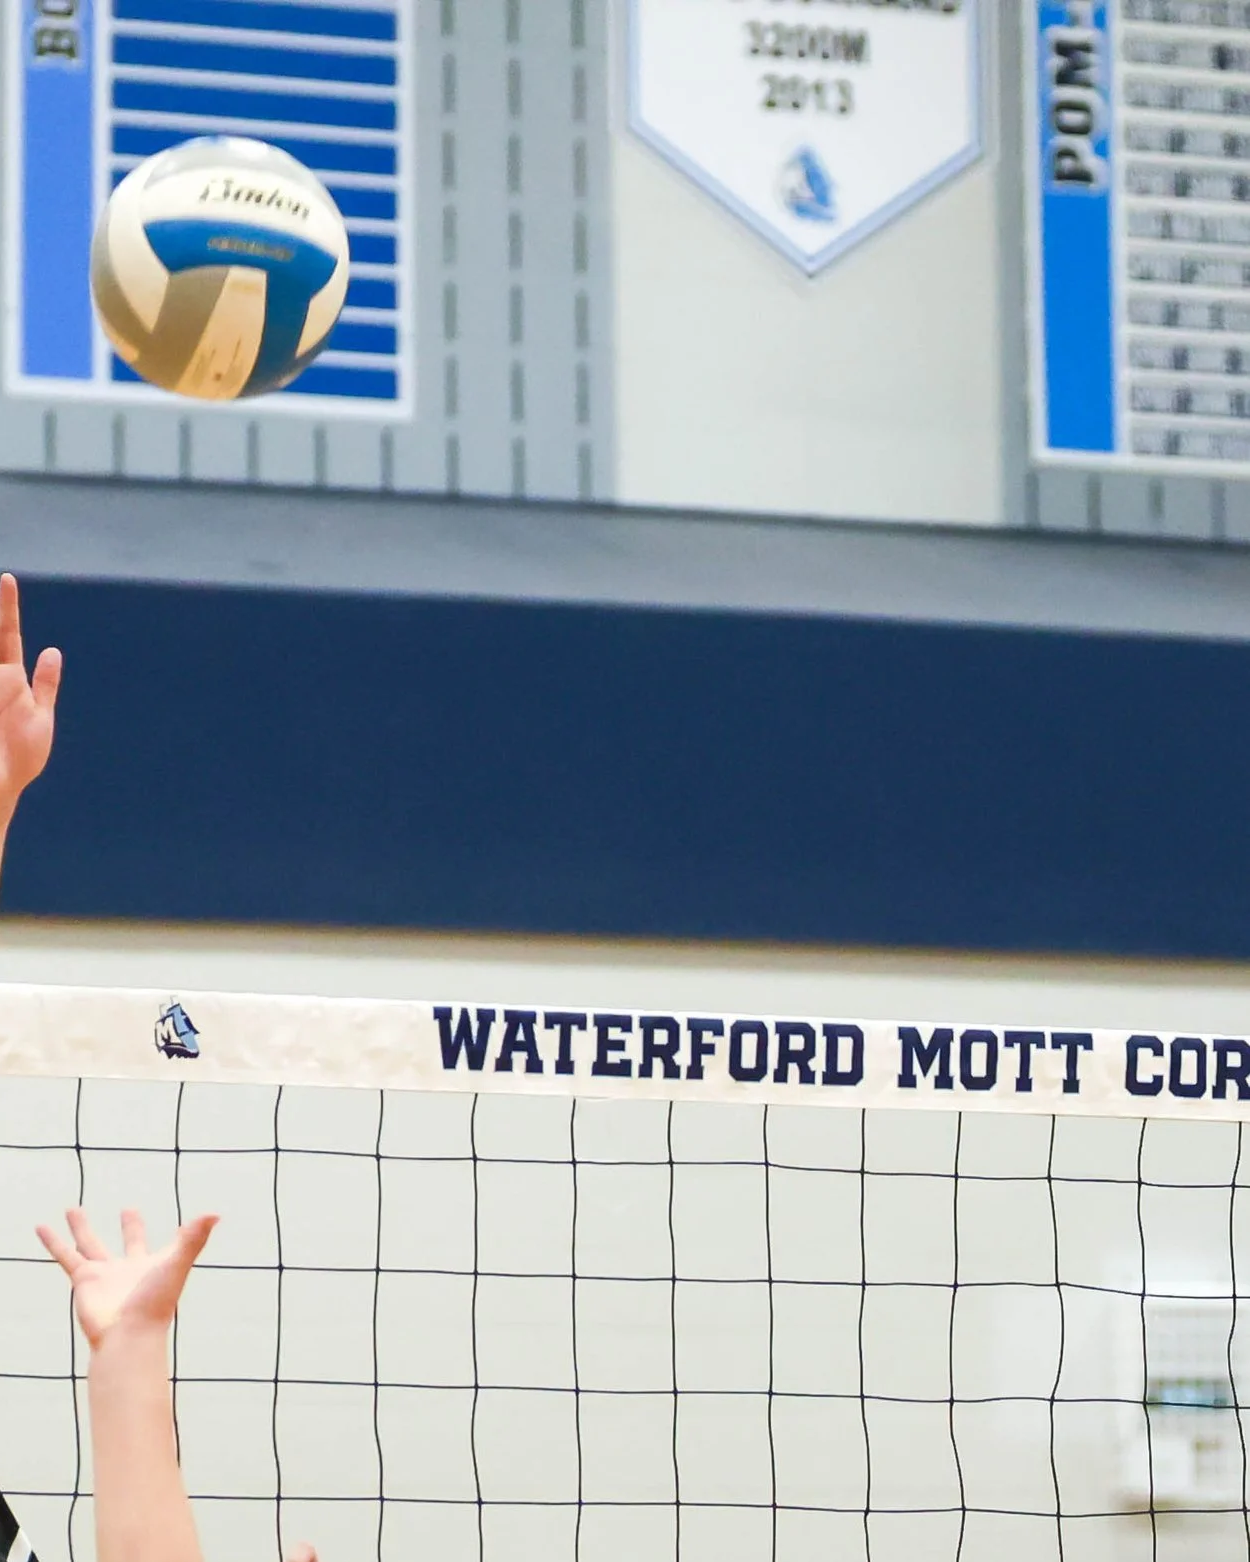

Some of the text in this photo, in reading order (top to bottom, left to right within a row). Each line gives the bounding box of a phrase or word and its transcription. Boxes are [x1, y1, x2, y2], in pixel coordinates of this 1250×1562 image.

[743, 21, 869, 62] 3200M
[762, 74, 855, 114] 2013
[433, 1007, 1250, 1101] WATERFORD MOTT COR
